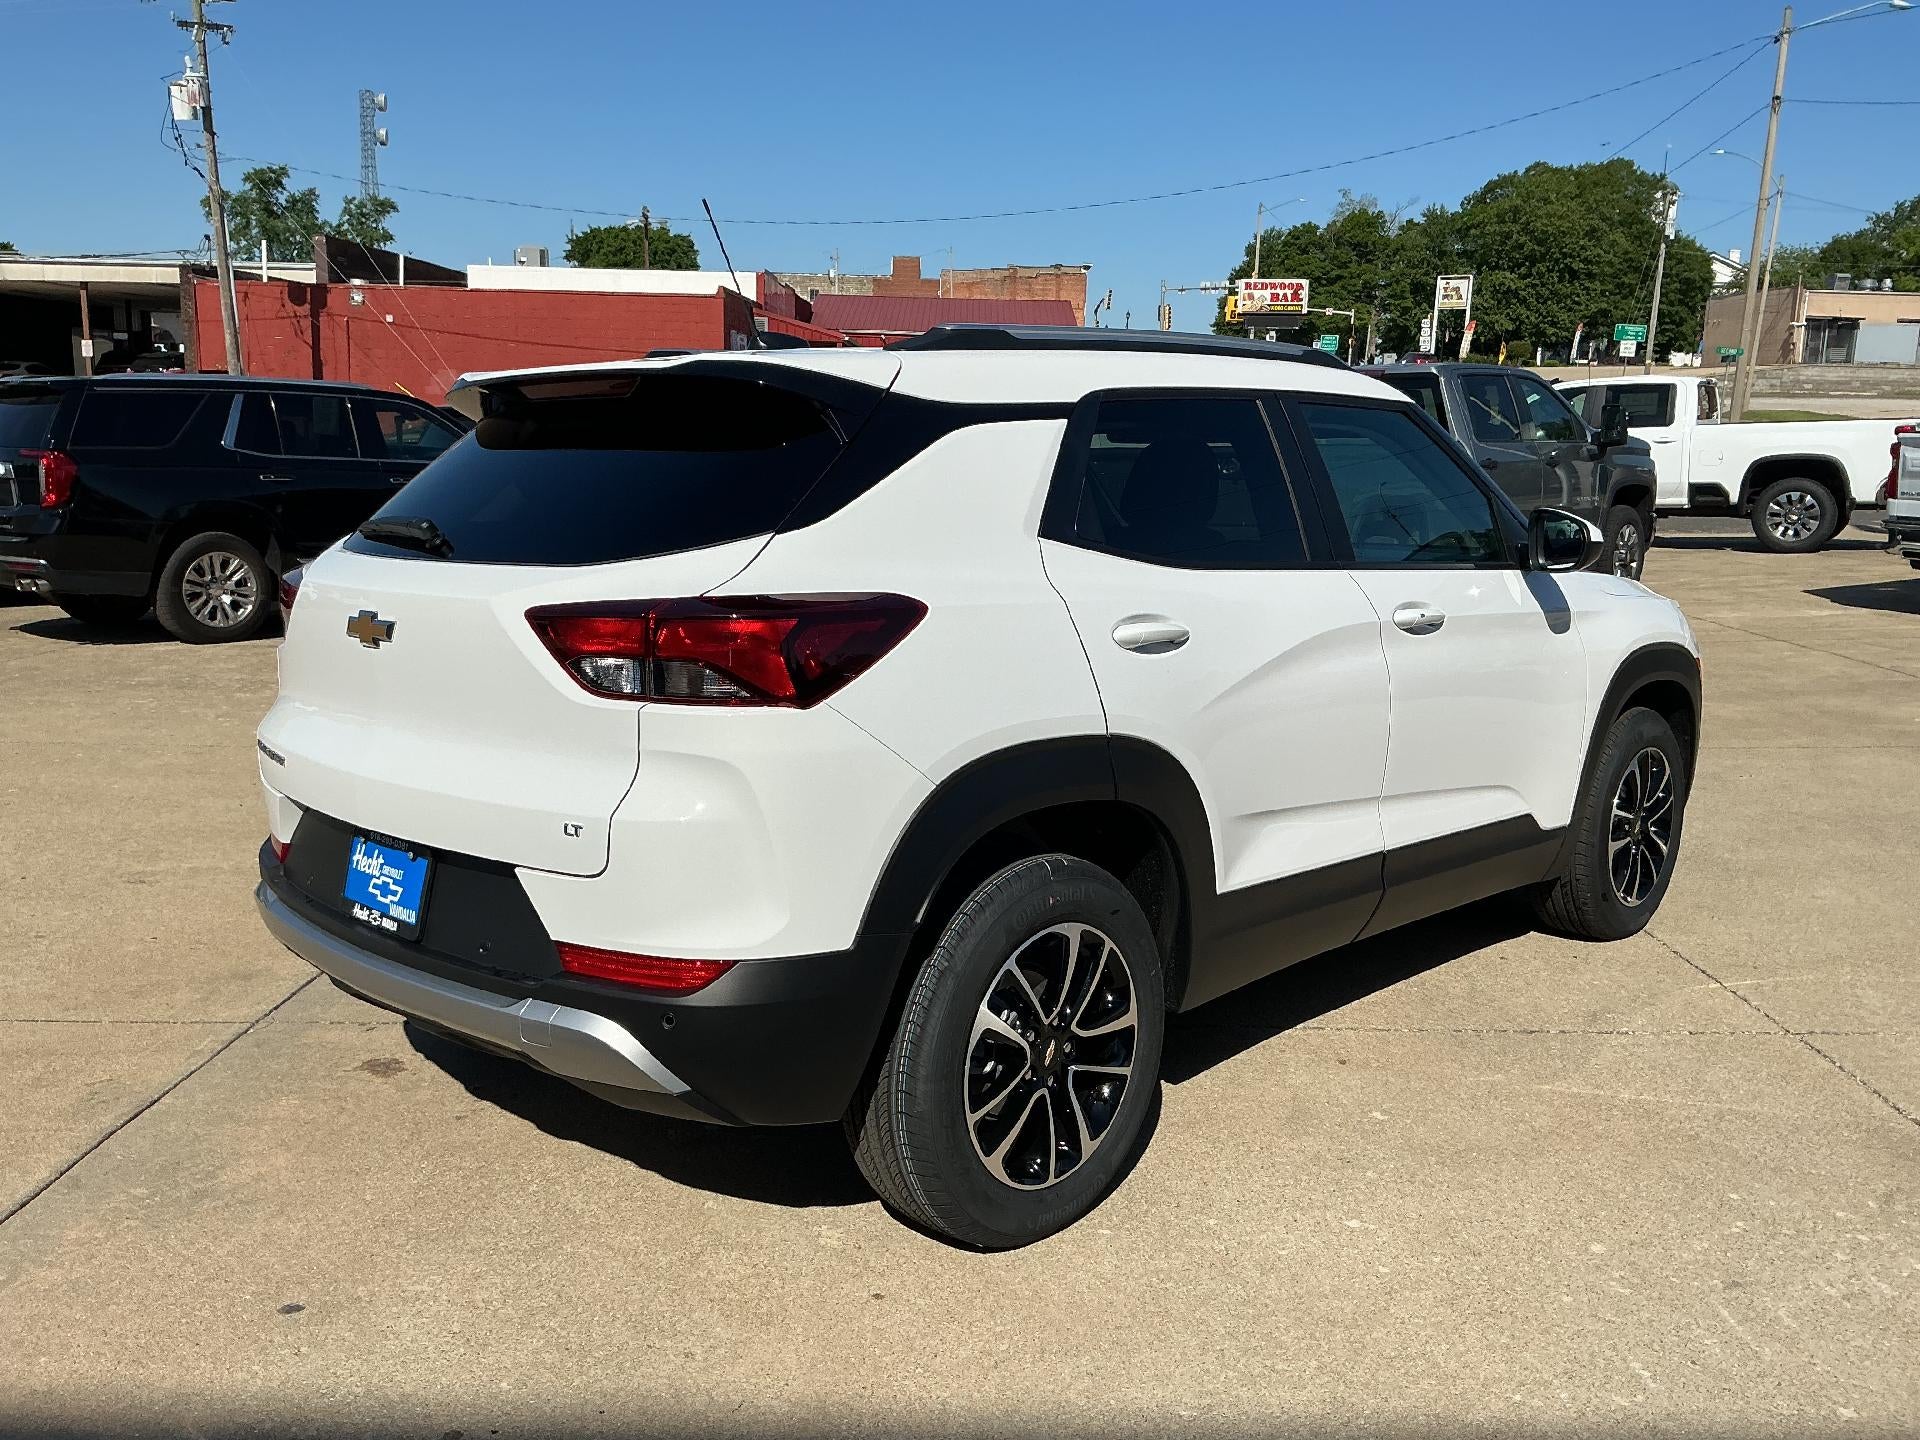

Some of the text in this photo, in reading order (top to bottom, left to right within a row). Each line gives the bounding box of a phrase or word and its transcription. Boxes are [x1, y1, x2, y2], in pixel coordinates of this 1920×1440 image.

[1244, 281, 1304, 291] REDWOOD
[1269, 292, 1303, 303] BAR
[563, 822, 584, 838] LT
[353, 843, 384, 877] Hecht
